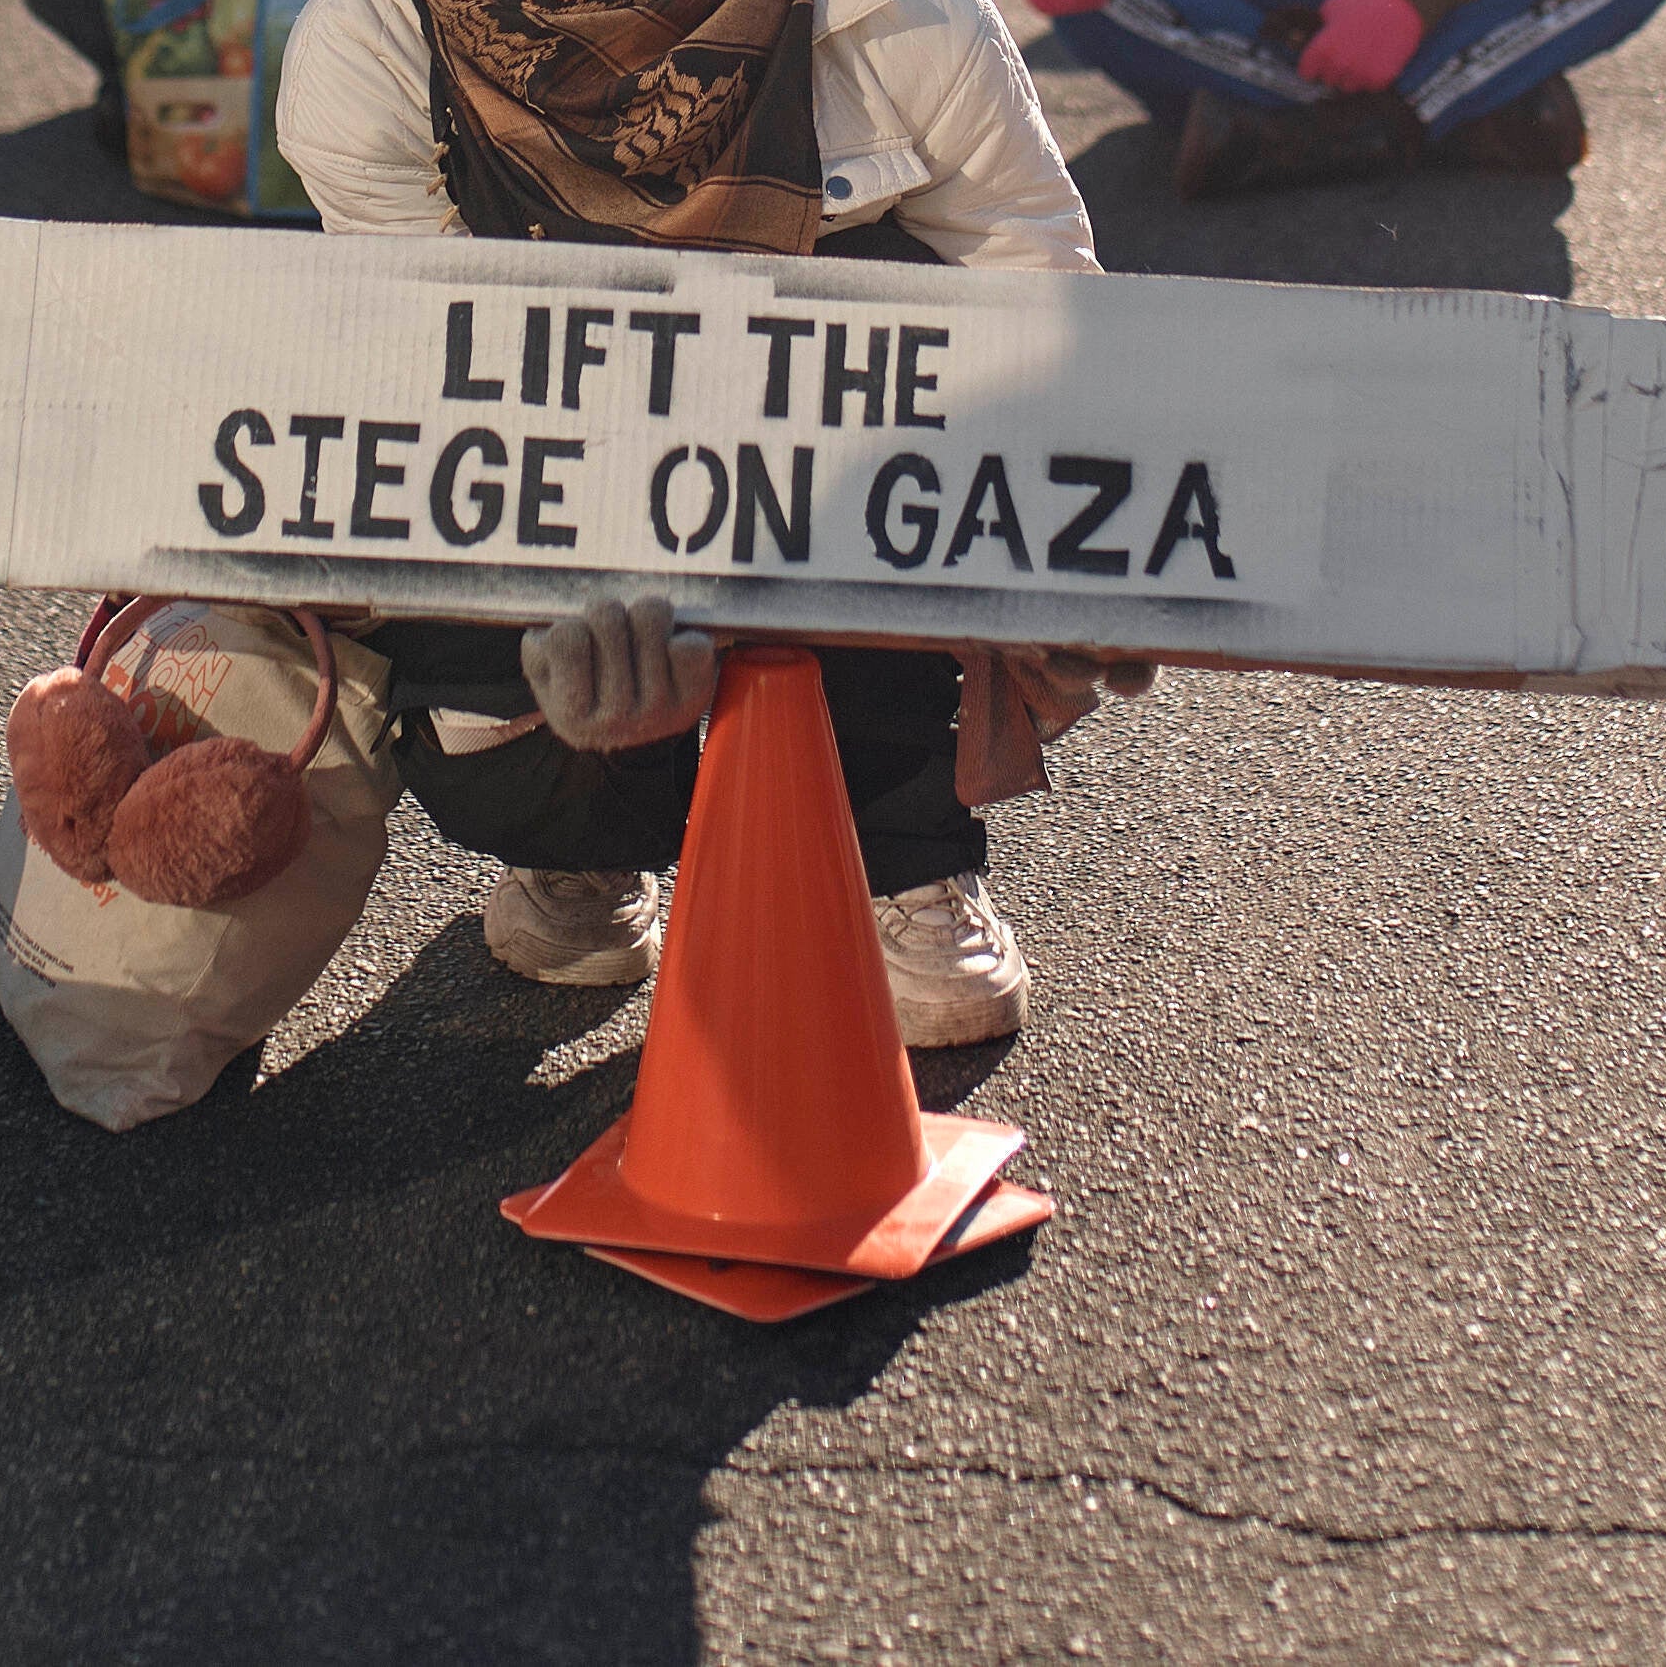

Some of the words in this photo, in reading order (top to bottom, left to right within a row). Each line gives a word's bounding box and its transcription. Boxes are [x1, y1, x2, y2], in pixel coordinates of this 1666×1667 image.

[443, 302, 700, 415] LIFT
[748, 317, 948, 430] THE
[199, 410, 584, 546] SIEGE
[651, 445, 813, 562] ON
[866, 453, 1235, 579] GAZA
